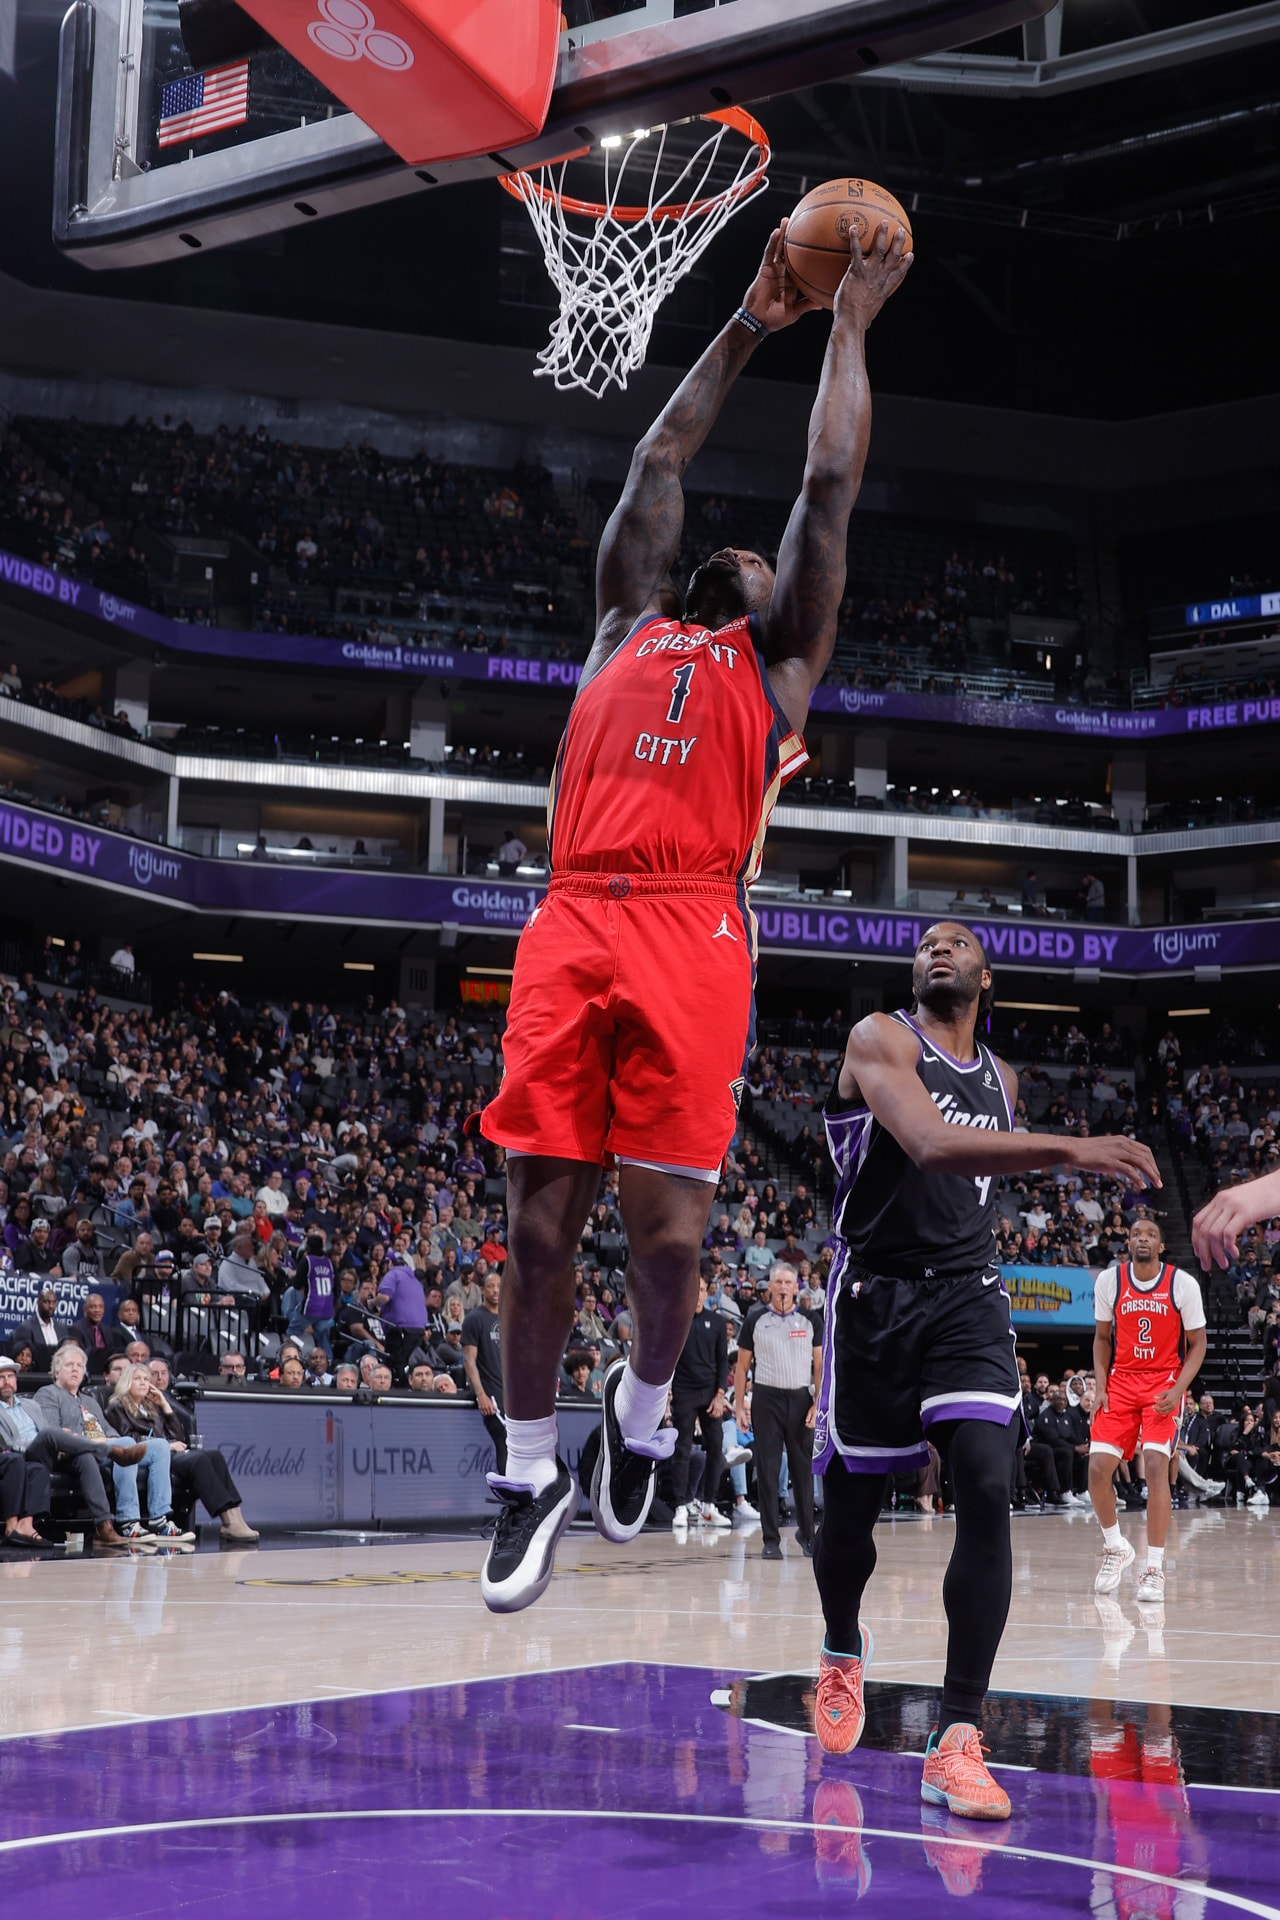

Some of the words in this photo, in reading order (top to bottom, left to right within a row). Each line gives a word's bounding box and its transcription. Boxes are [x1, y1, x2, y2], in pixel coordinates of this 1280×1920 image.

[59, 578, 80, 605] BY
[1211, 602, 1241, 619] DAL
[404, 651, 454, 669] CENTER
[635, 629, 738, 669] CRESCNT
[488, 657, 541, 682] FREE
[666, 662, 696, 724] 1
[1110, 717, 1156, 730] CENTER
[1187, 704, 1238, 729] FREE
[634, 732, 697, 765] CITY
[0, 811, 64, 857] IDED
[70, 832, 100, 867] BY
[452, 887, 525, 912] Golden
[856, 917, 920, 947] WIFI
[1084, 934, 1118, 962] BY
[42, 1281, 90, 1299] OFFICE
[315, 1277, 331, 1296] 10
[0, 1294, 79, 1317] UTOMON
[1121, 1299, 1169, 1316] CRESCENT
[1138, 1317, 1152, 1344] 2
[1134, 1345, 1156, 1360] CITY
[217, 1442, 306, 1476] Michelob
[352, 1448, 435, 1475] ULTRA
